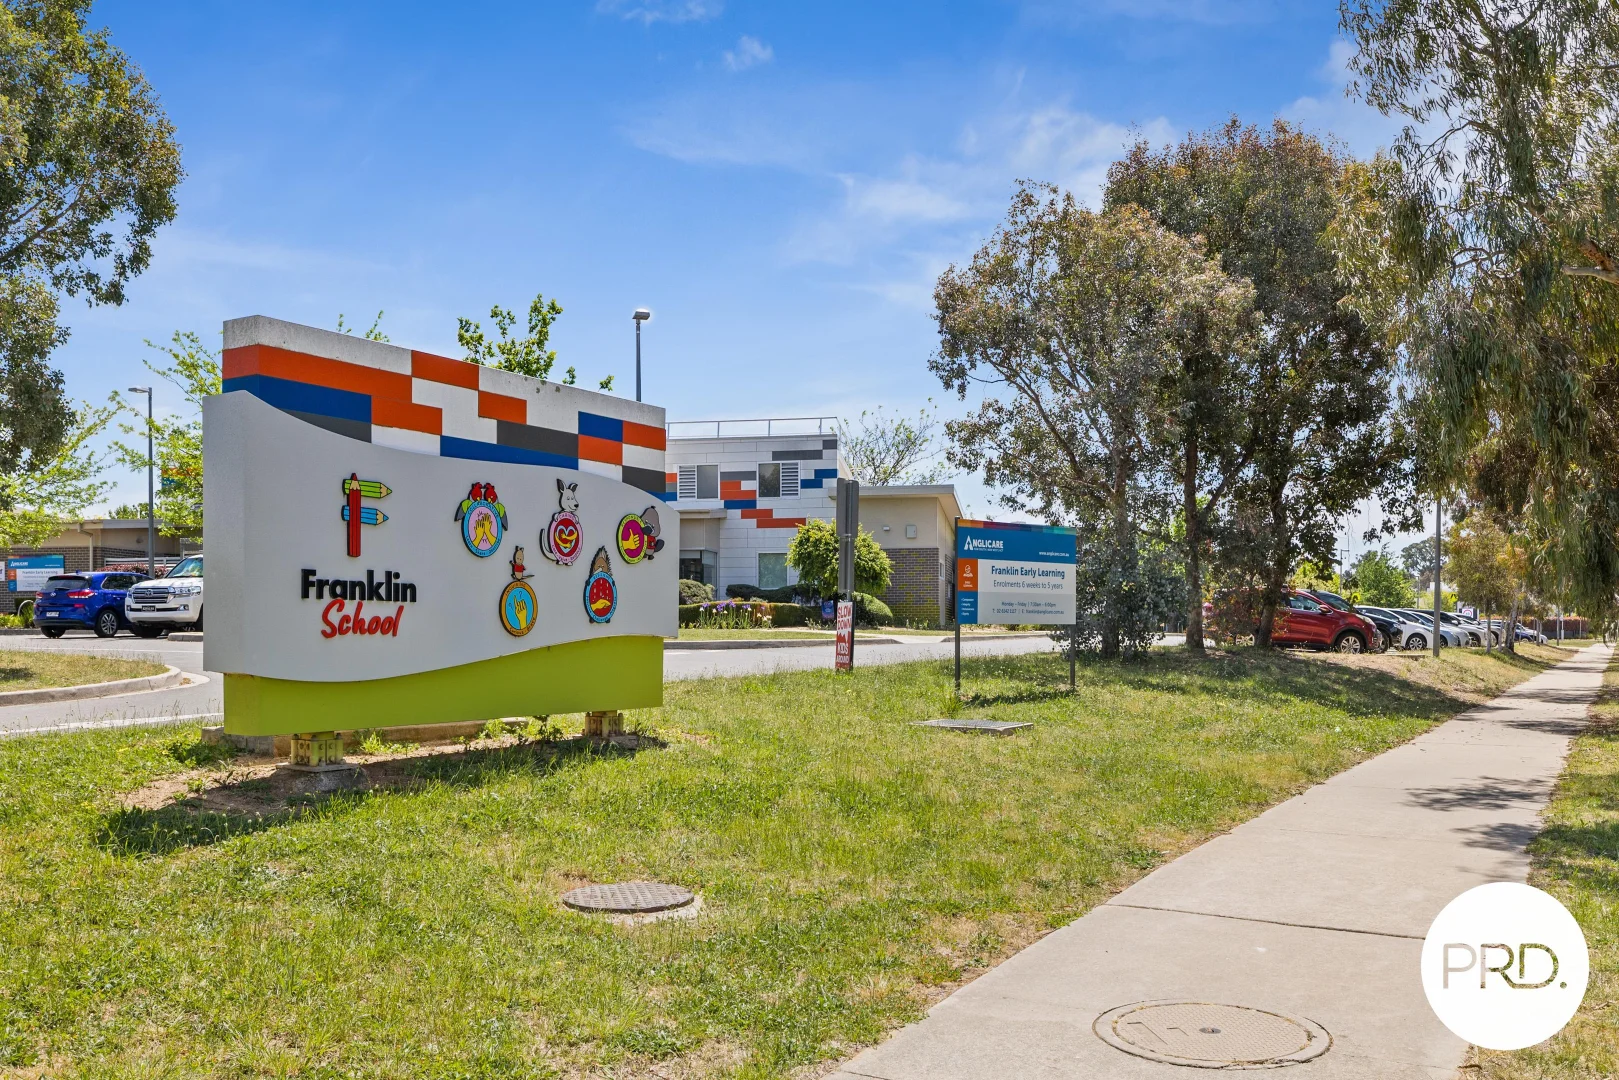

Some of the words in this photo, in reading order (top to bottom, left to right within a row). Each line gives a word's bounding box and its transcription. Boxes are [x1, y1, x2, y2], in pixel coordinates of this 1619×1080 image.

[964, 535, 1004, 551] ANGLICARE
[991, 566, 1019, 576] Franklin
[1020, 567, 1036, 578] Early
[1038, 568, 1065, 579] Learning
[301, 568, 417, 602] Franklin
[993, 580, 1021, 588] Enrolments
[1026, 581, 1040, 589] weeks
[321, 597, 404, 639] School
[837, 606, 852, 619] SLOW
[837, 618, 852, 630] DOWN
[837, 643, 849, 655] KIDS
